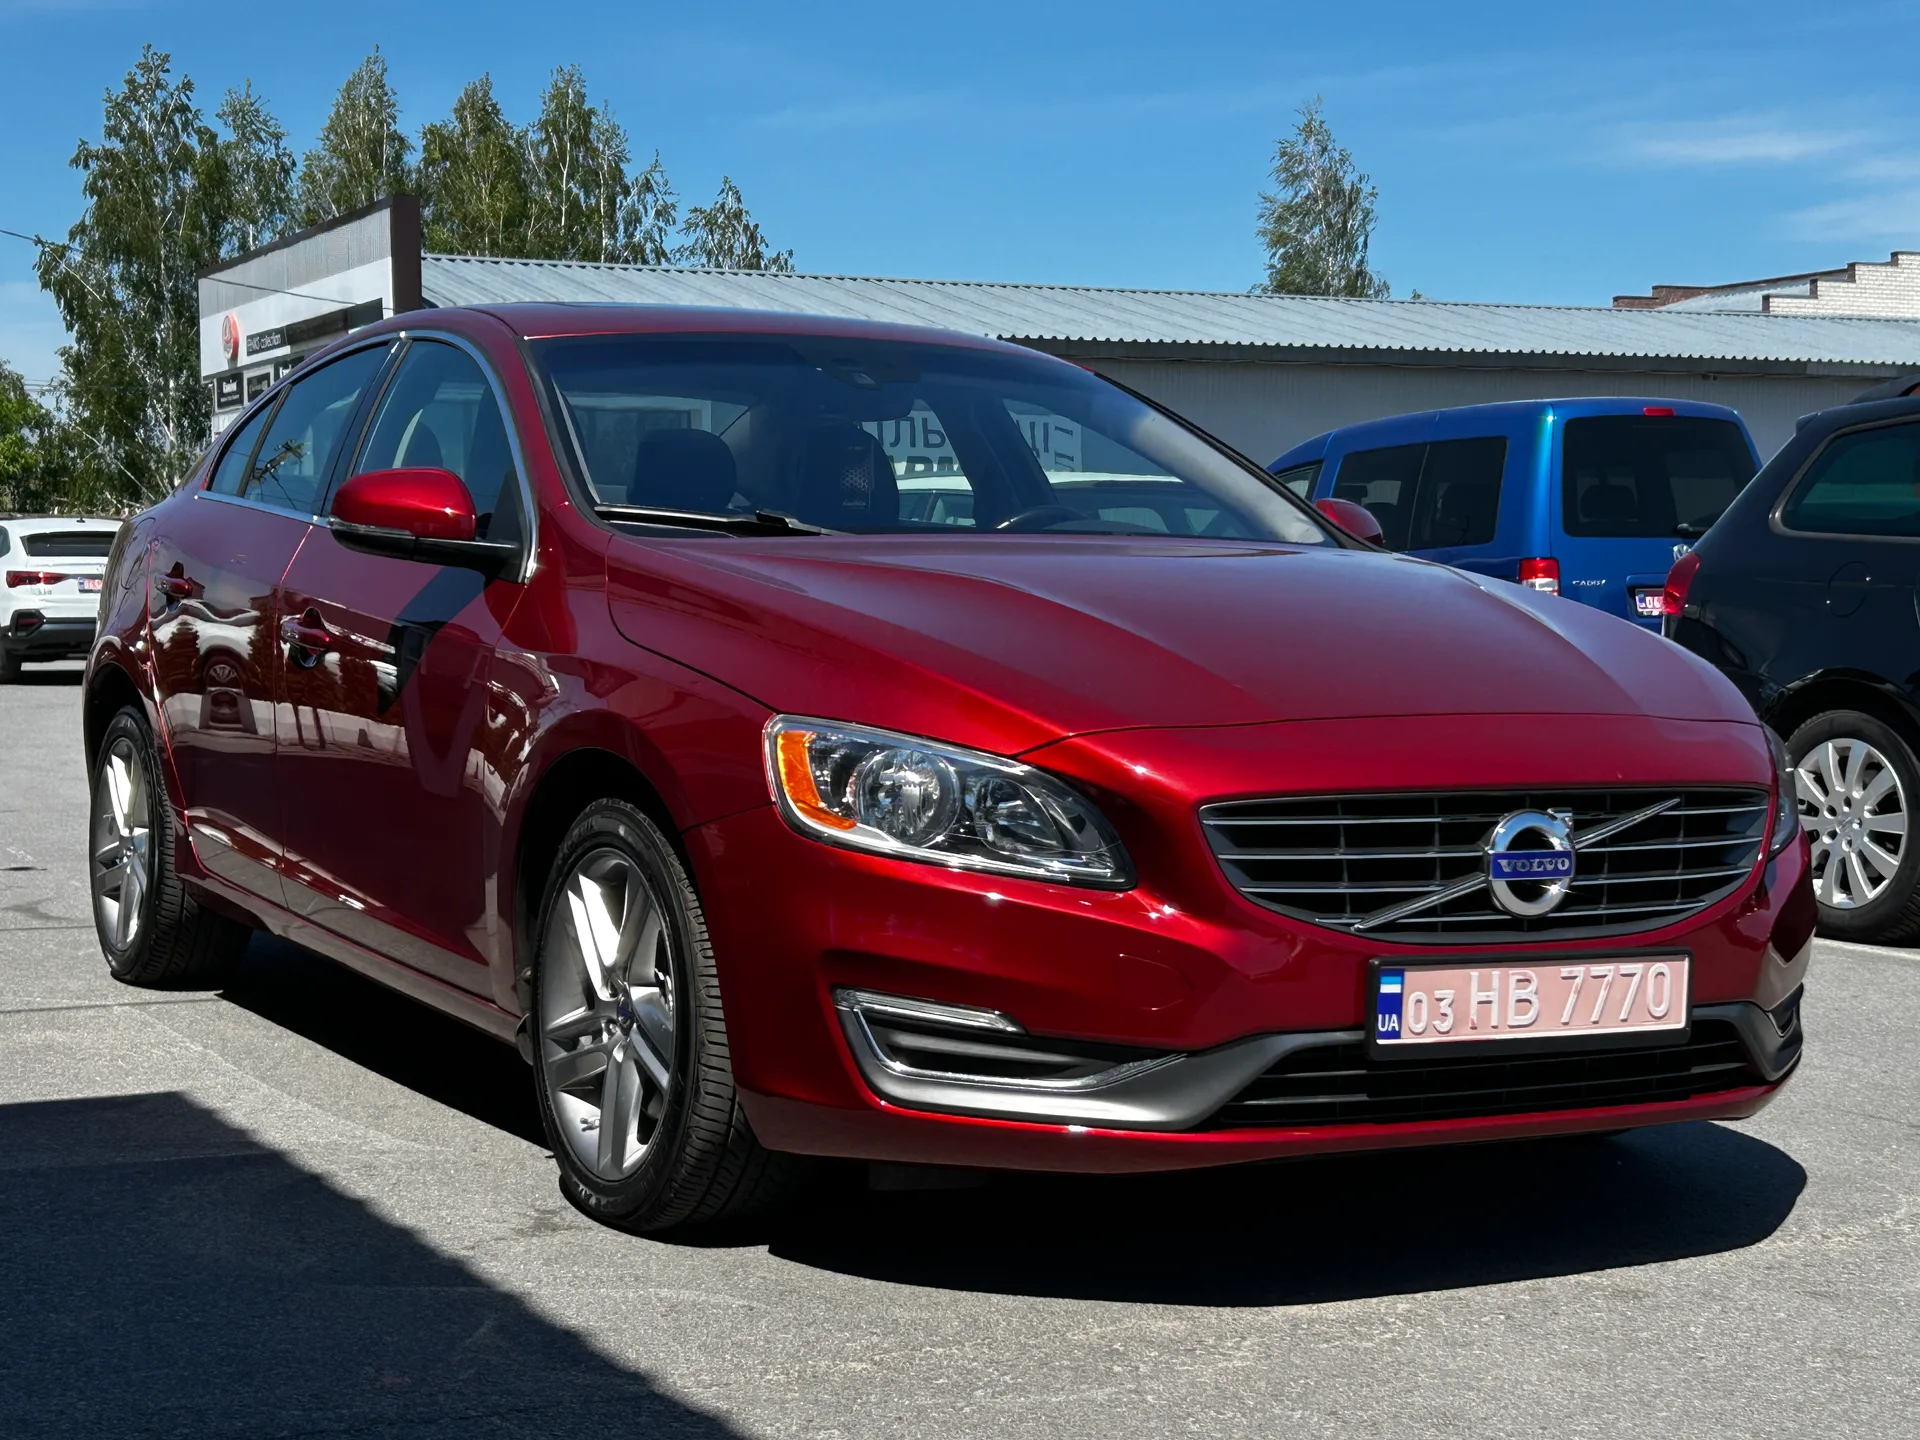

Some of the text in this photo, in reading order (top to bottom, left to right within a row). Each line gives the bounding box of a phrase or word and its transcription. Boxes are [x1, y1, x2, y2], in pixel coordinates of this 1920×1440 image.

[1497, 857, 1570, 873] VOLVO
[1407, 962, 1671, 1035] 03 HB 7770
[1377, 1013, 1399, 1033] UA
